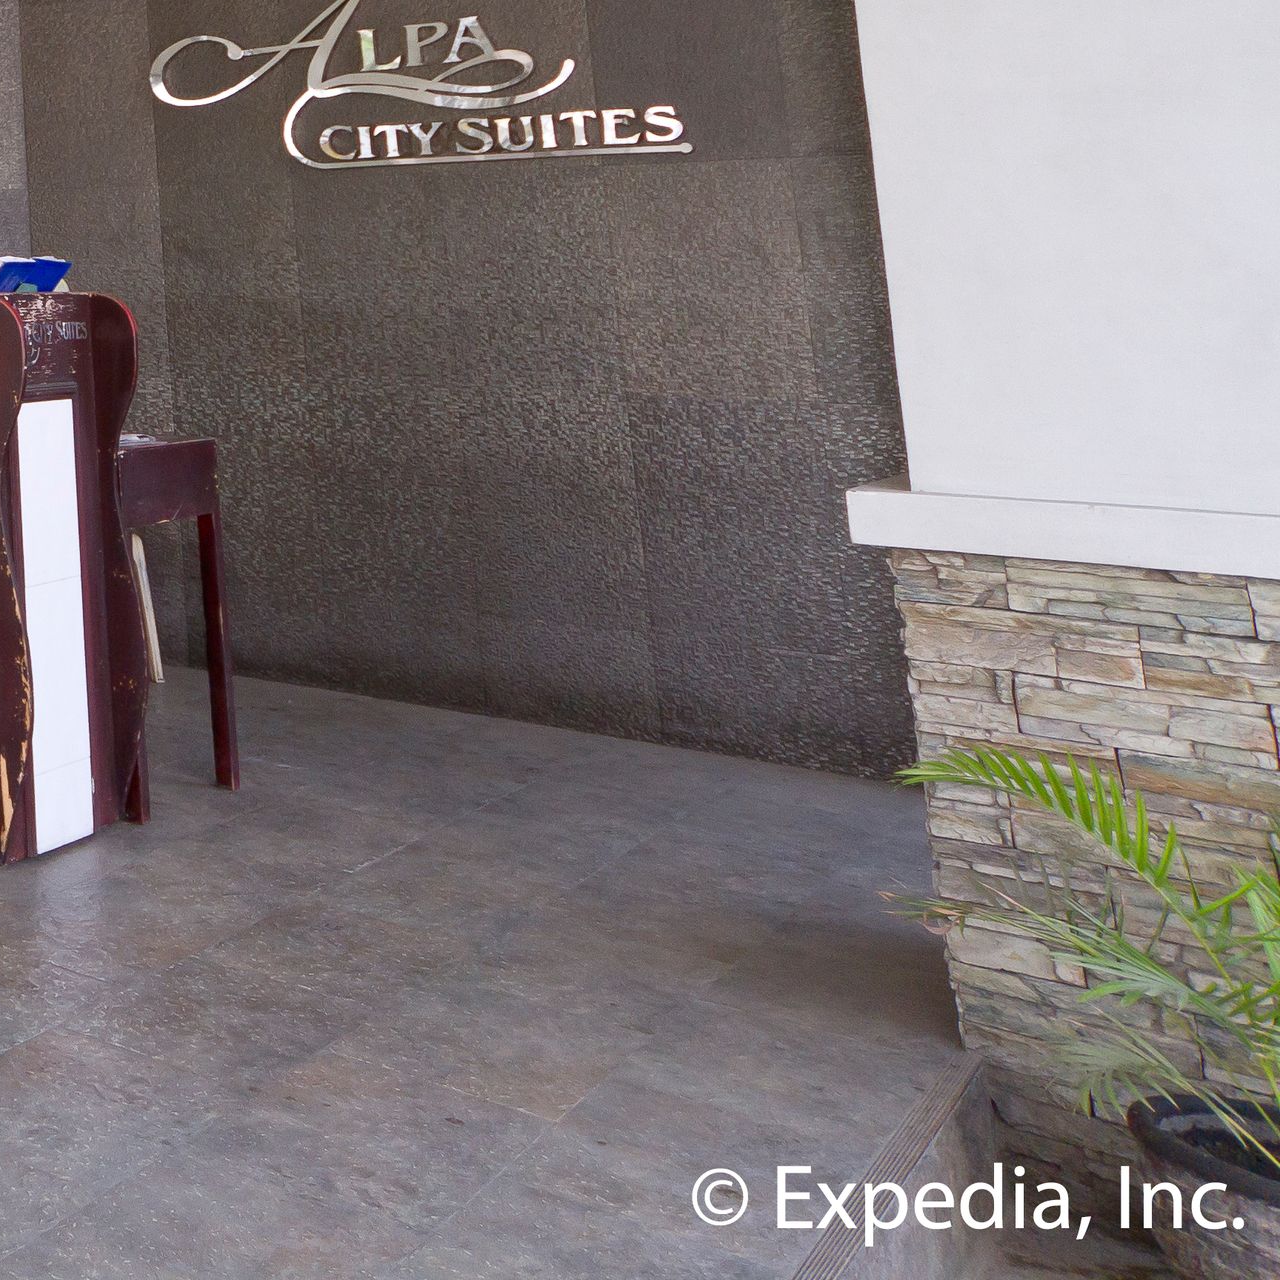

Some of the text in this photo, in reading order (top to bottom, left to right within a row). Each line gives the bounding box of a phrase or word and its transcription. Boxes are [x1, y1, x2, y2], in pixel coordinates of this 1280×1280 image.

[319, 106, 685, 160] CITY SUITES
[55, 320, 88, 341] SUITES
